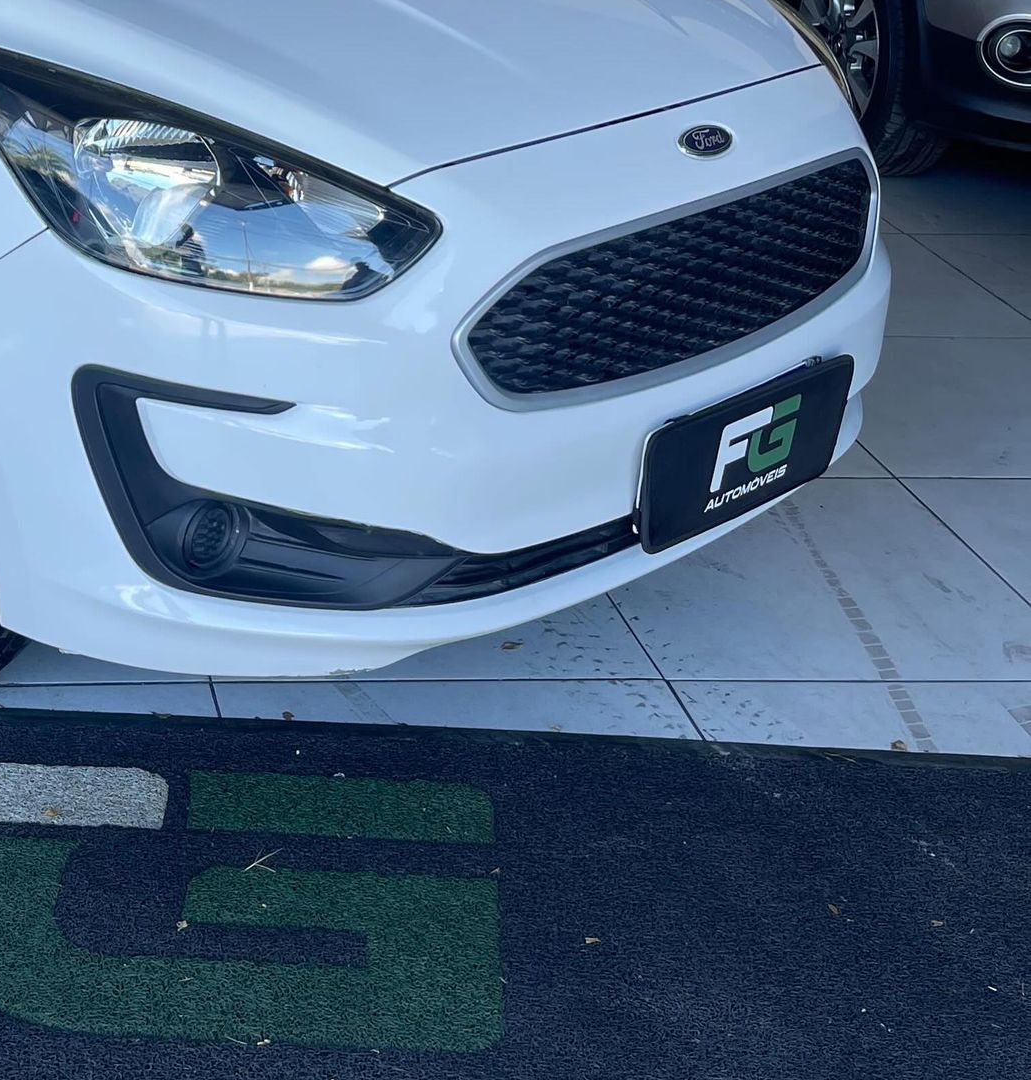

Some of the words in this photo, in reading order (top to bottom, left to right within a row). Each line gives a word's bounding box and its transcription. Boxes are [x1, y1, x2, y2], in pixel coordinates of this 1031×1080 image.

[692, 129, 724, 150] Ford
[710, 394, 802, 493] FG
[704, 464, 787, 513] AUTOMÓVEIS
